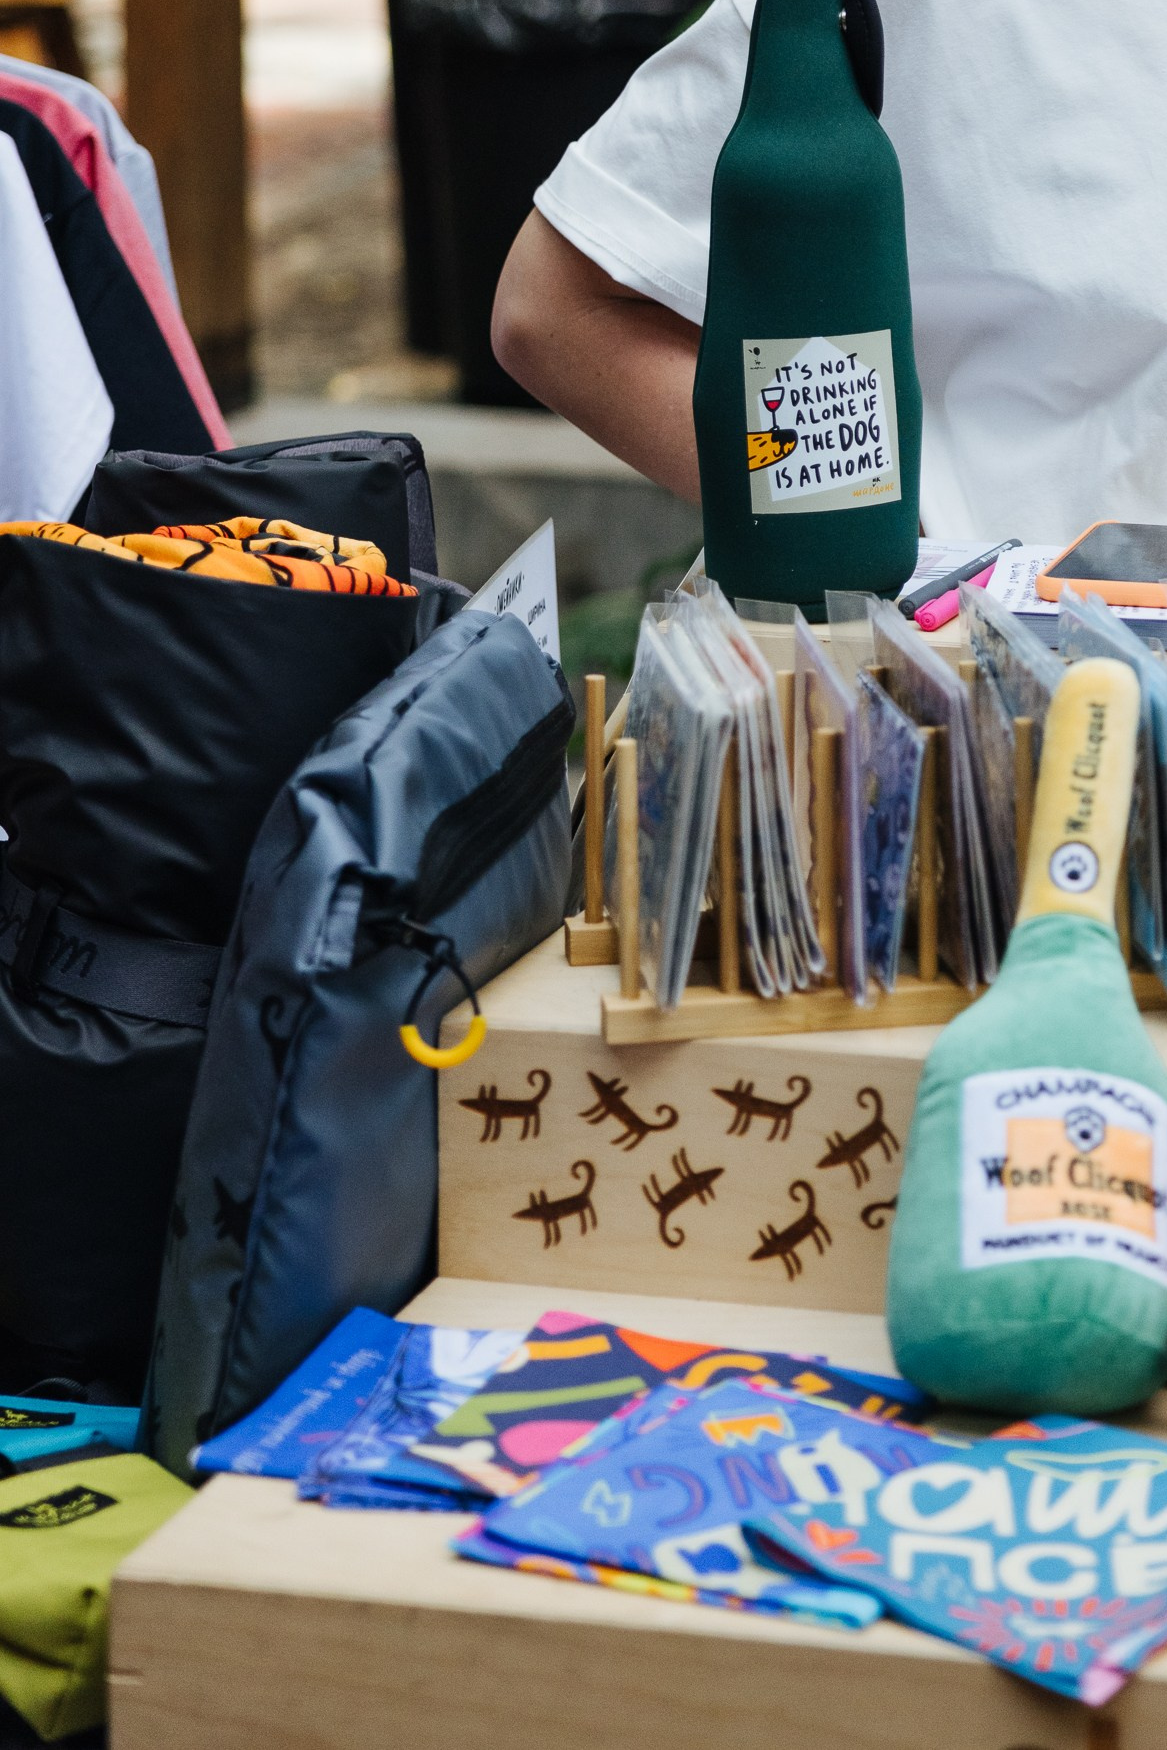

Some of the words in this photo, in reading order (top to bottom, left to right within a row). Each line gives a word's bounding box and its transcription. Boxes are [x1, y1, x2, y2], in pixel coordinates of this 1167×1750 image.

[775, 361, 813, 383] IT'S
[820, 352, 858, 377] NOT
[790, 368, 877, 407] DRINKING
[795, 399, 858, 426] ALONE
[863, 394, 877, 412] IF
[800, 430, 836, 453] THE
[838, 413, 881, 452] DOG
[775, 466, 793, 489] IS
[800, 463, 822, 487] AT
[829, 446, 890, 479] HOME.
[981, 1153, 1058, 1191] Woof
